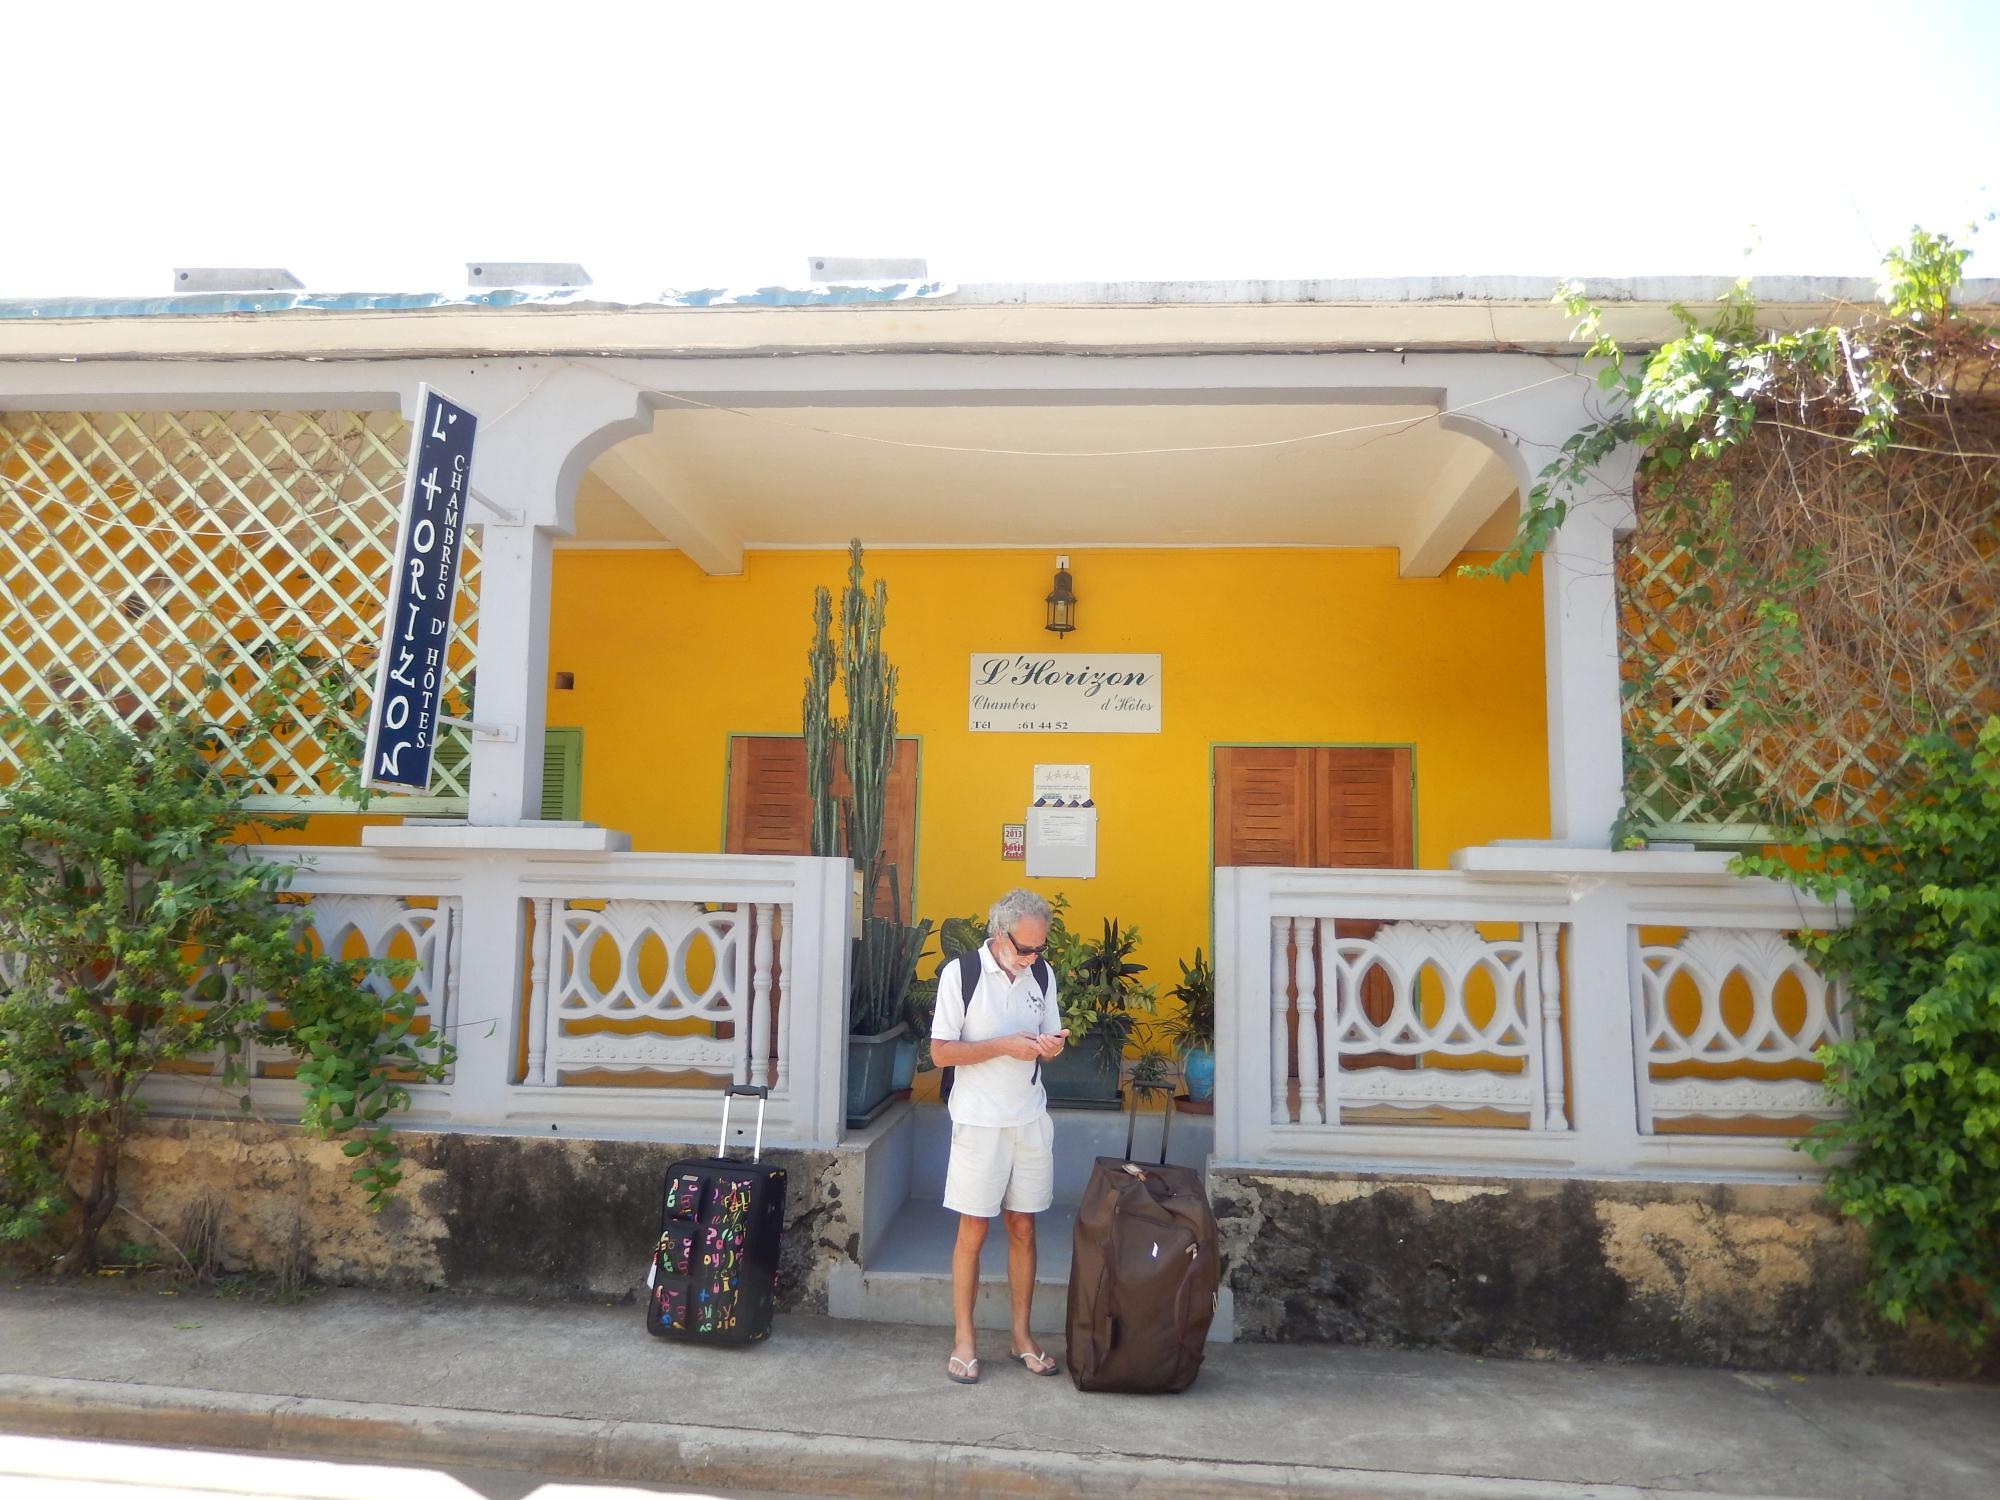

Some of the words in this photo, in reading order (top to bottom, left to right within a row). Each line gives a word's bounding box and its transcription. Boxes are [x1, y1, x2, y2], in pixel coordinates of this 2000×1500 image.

[436, 454, 465, 601] CHAMBRES
[975, 655, 1155, 698] L'Horizon
[972, 694, 1039, 711] Chambres
[973, 720, 992, 730] Tél
[1038, 721, 1052, 730] 44
[1055, 721, 1069, 730] 52
[1005, 830, 1022, 838] 2013
